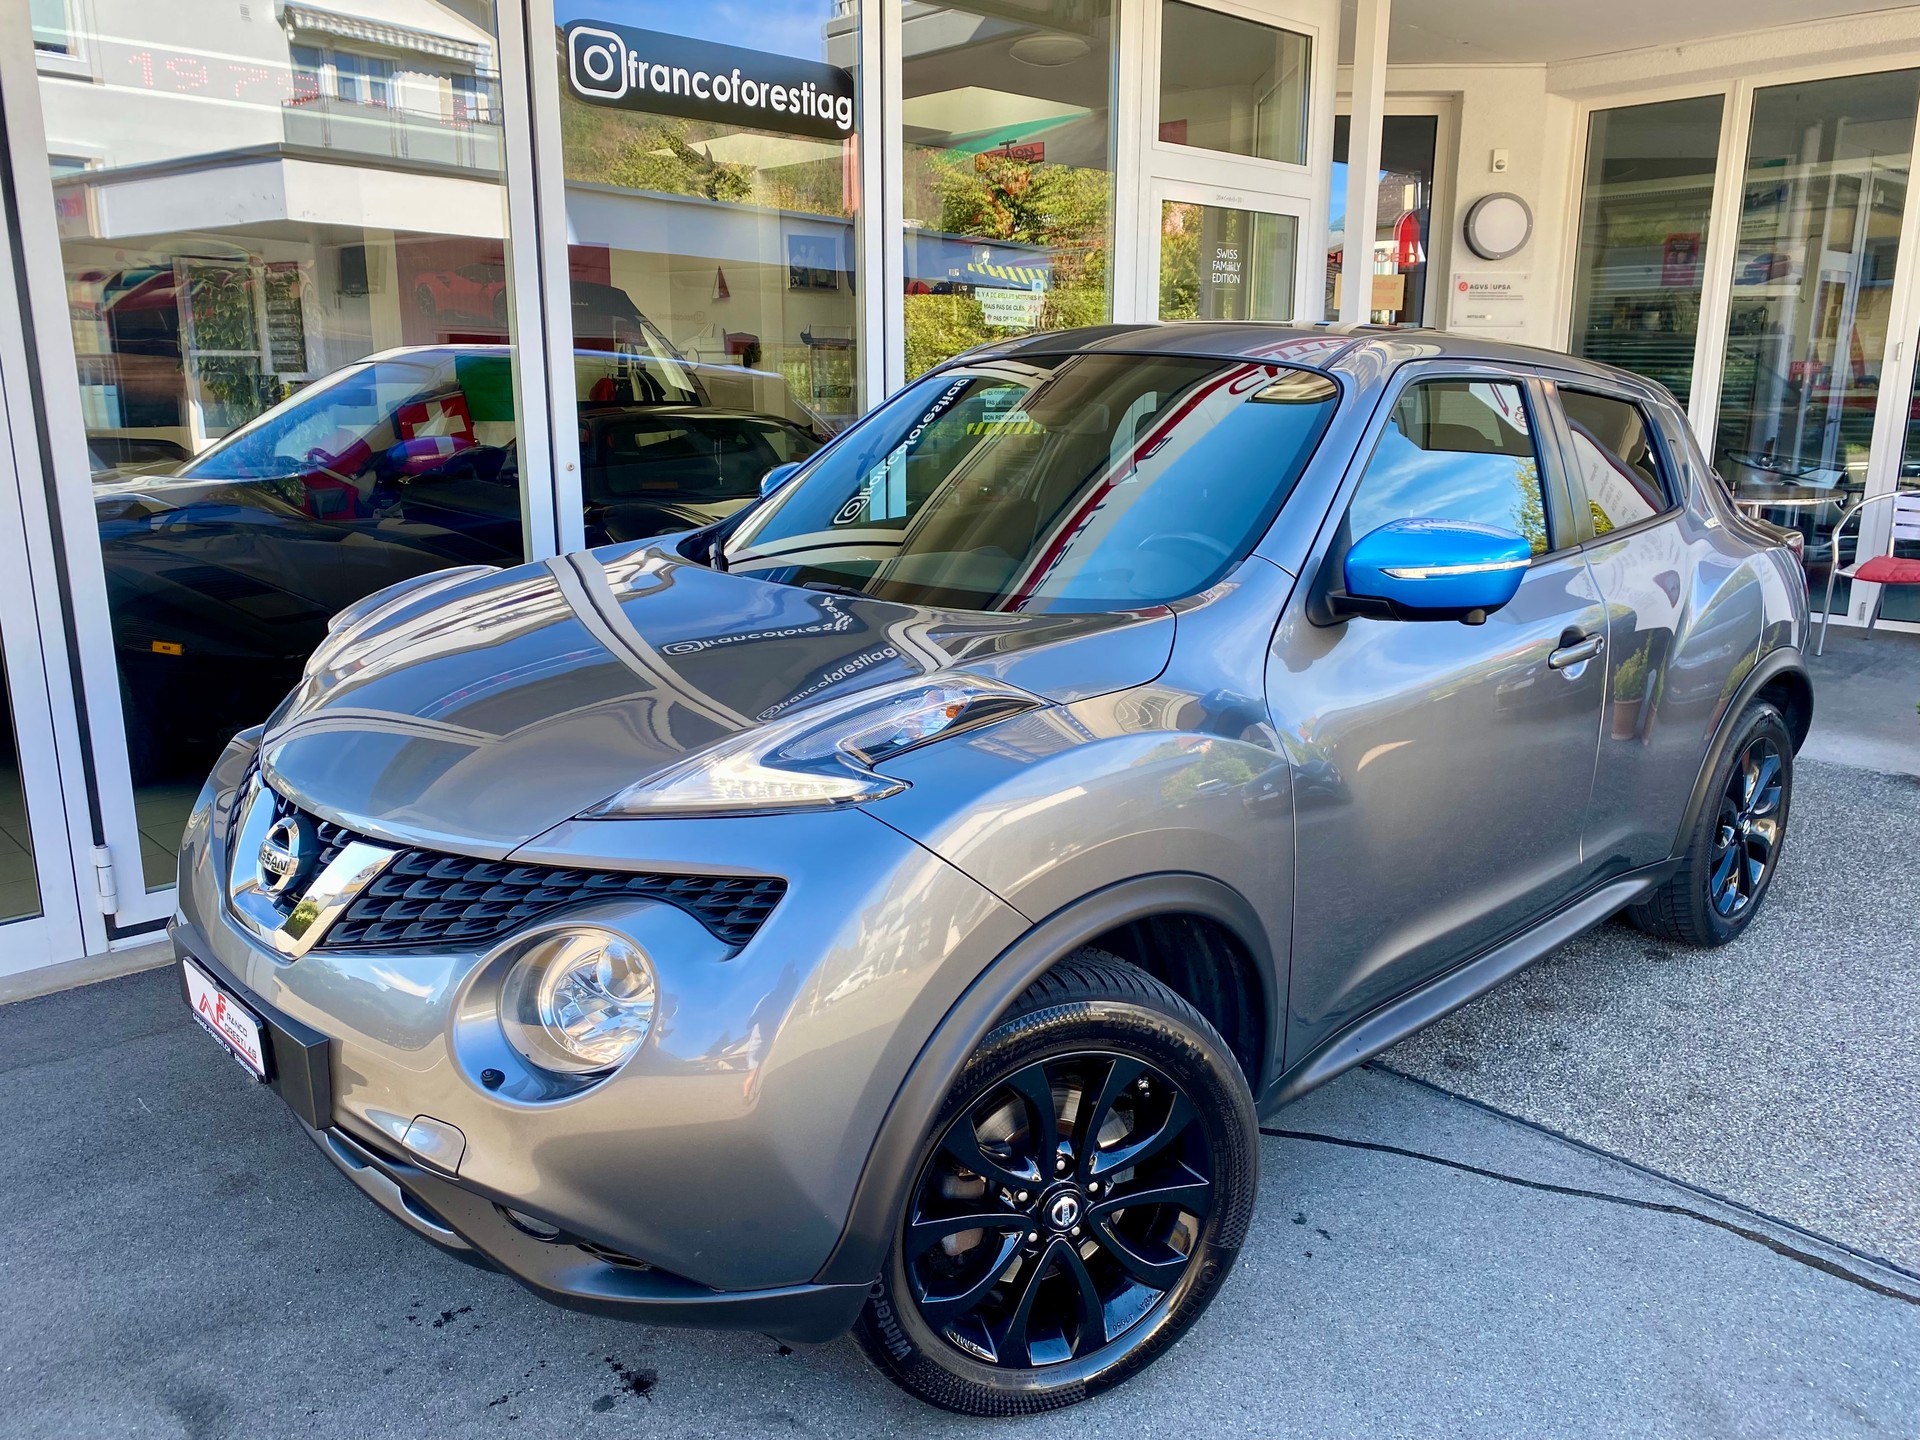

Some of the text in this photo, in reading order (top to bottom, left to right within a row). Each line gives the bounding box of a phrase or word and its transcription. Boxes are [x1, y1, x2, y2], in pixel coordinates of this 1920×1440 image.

[627, 49, 853, 131] francoforestiag
[1216, 248, 1238, 260] SWISS
[1211, 272, 1241, 284] EDITION
